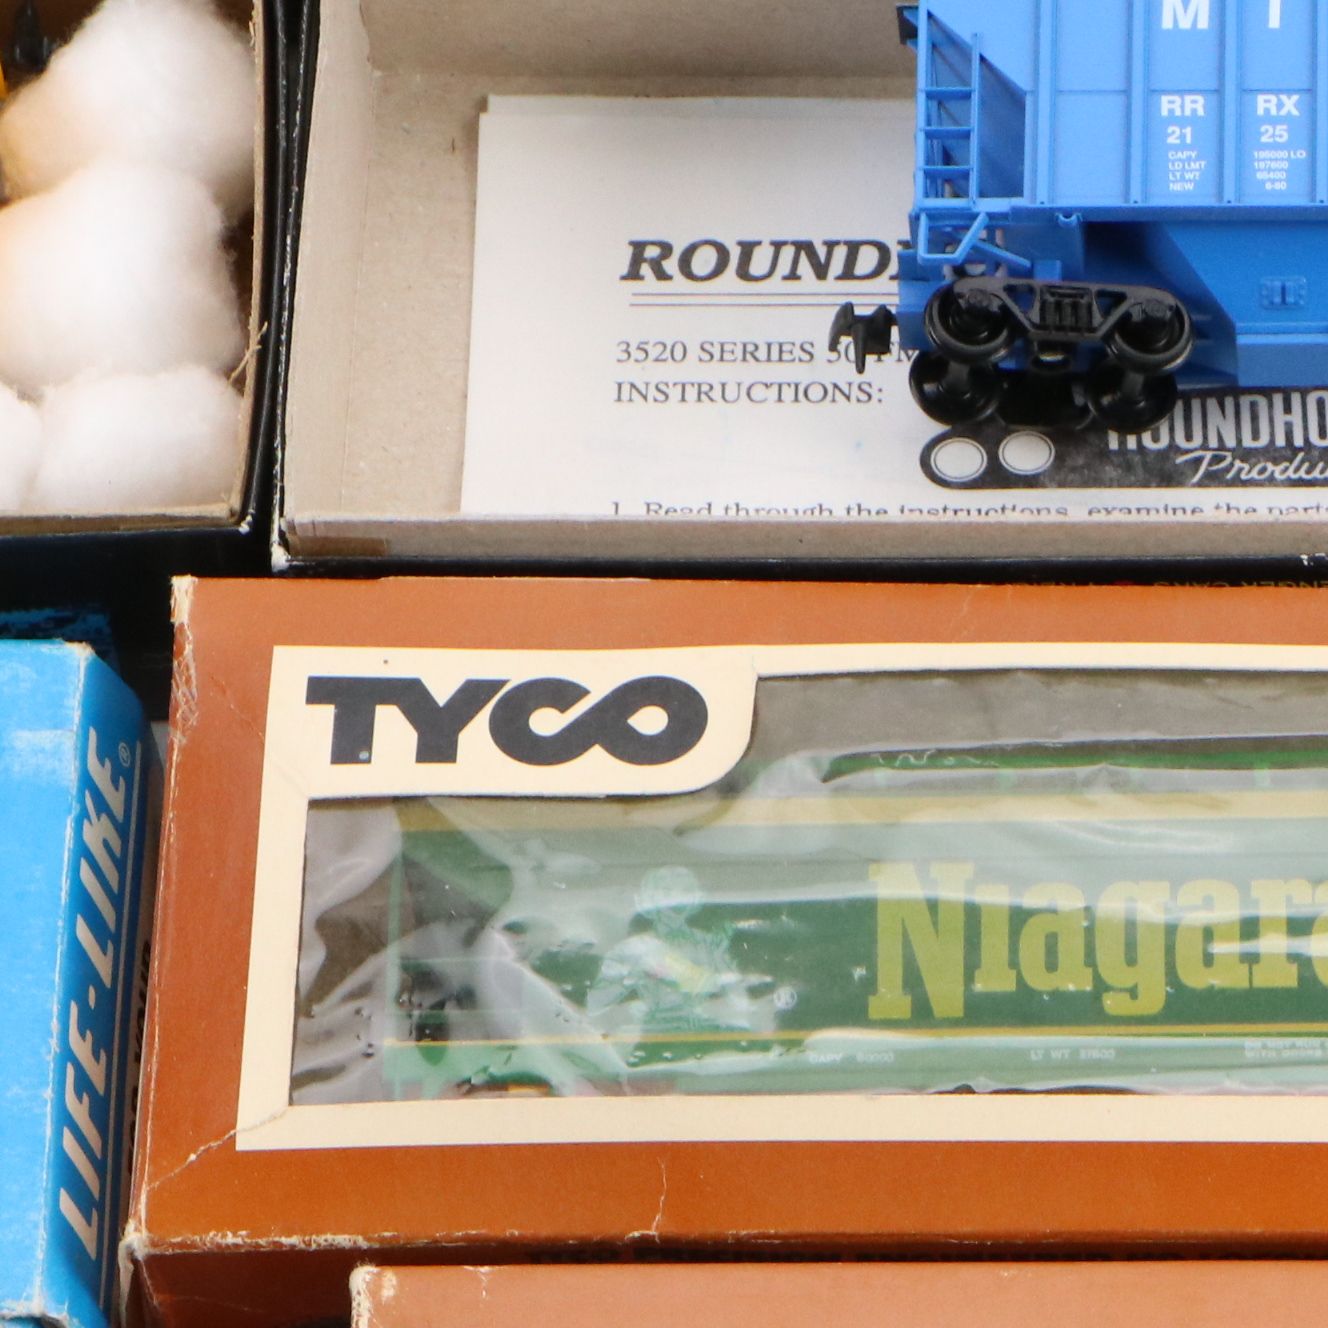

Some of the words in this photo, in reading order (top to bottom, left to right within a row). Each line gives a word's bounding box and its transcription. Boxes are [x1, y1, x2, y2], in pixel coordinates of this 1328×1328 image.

[1160, 94, 1205, 117] RR
[1256, 93, 1301, 117] RX
[1166, 125, 1192, 144] 21
[1259, 124, 1289, 143] 25
[1168, 151, 1198, 160] CAPY
[619, 238, 912, 282] ROUND
[615, 340, 688, 364] 3520
[697, 340, 815, 364] SERIES
[613, 379, 884, 405] INSTRUCTIONS:
[305, 676, 709, 767] TYCO
